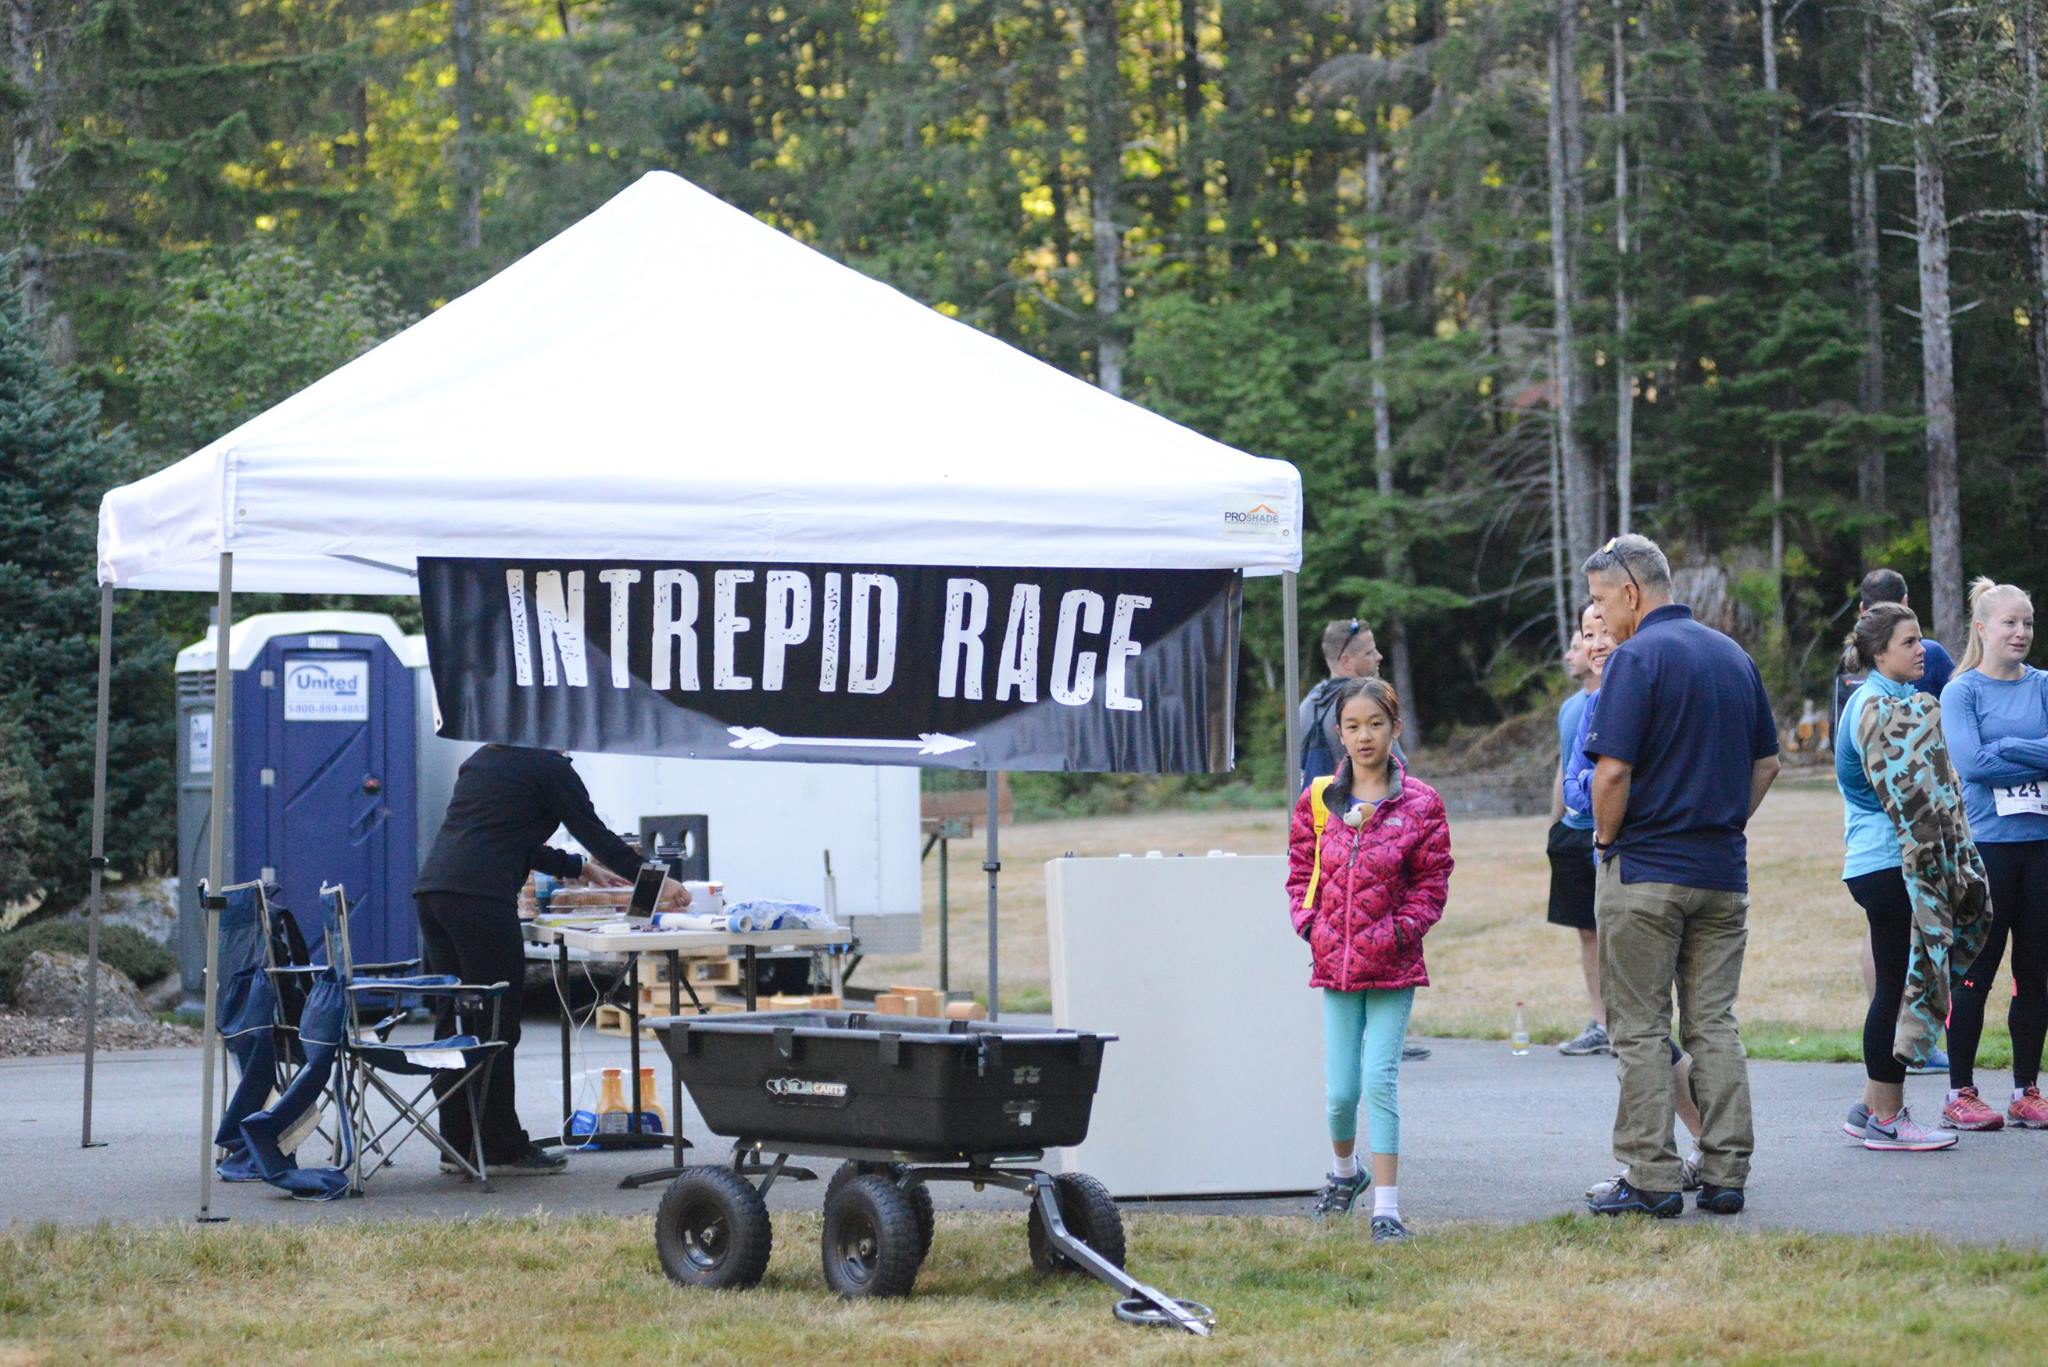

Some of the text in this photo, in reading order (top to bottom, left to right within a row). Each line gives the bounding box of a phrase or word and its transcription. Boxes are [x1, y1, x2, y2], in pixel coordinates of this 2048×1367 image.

[1224, 511, 1279, 523] PROSHADE
[505, 568, 1152, 711] INTREPID RACE
[296, 674, 358, 690] United
[813, 1083, 846, 1095] CARTS
